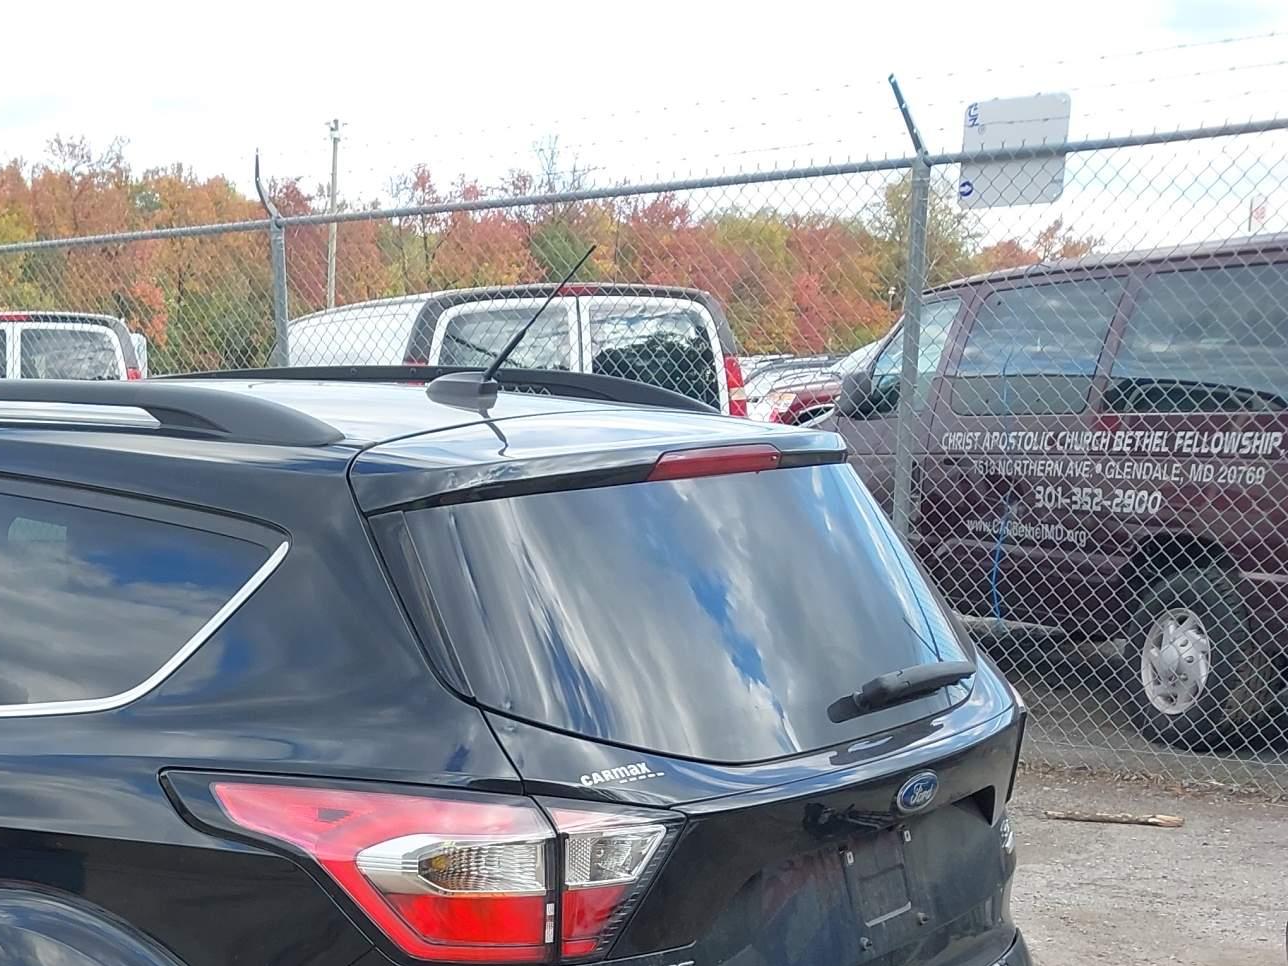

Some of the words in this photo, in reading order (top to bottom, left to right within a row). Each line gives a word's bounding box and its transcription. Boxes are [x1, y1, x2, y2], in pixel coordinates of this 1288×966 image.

[942, 432, 979, 450] CHRIST
[982, 431, 1053, 451] APOSTOLIC
[1056, 431, 1110, 451] CHURCH
[1113, 431, 1169, 452] BETHEL
[998, 460, 1062, 477] NORTHERN
[1065, 461, 1093, 478] AVE.
[1105, 462, 1184, 484] GLENDALE,
[1189, 464, 1214, 482] MD
[1218, 466, 1265, 484] 20769
[1034, 485, 1162, 515] 301-352-2900
